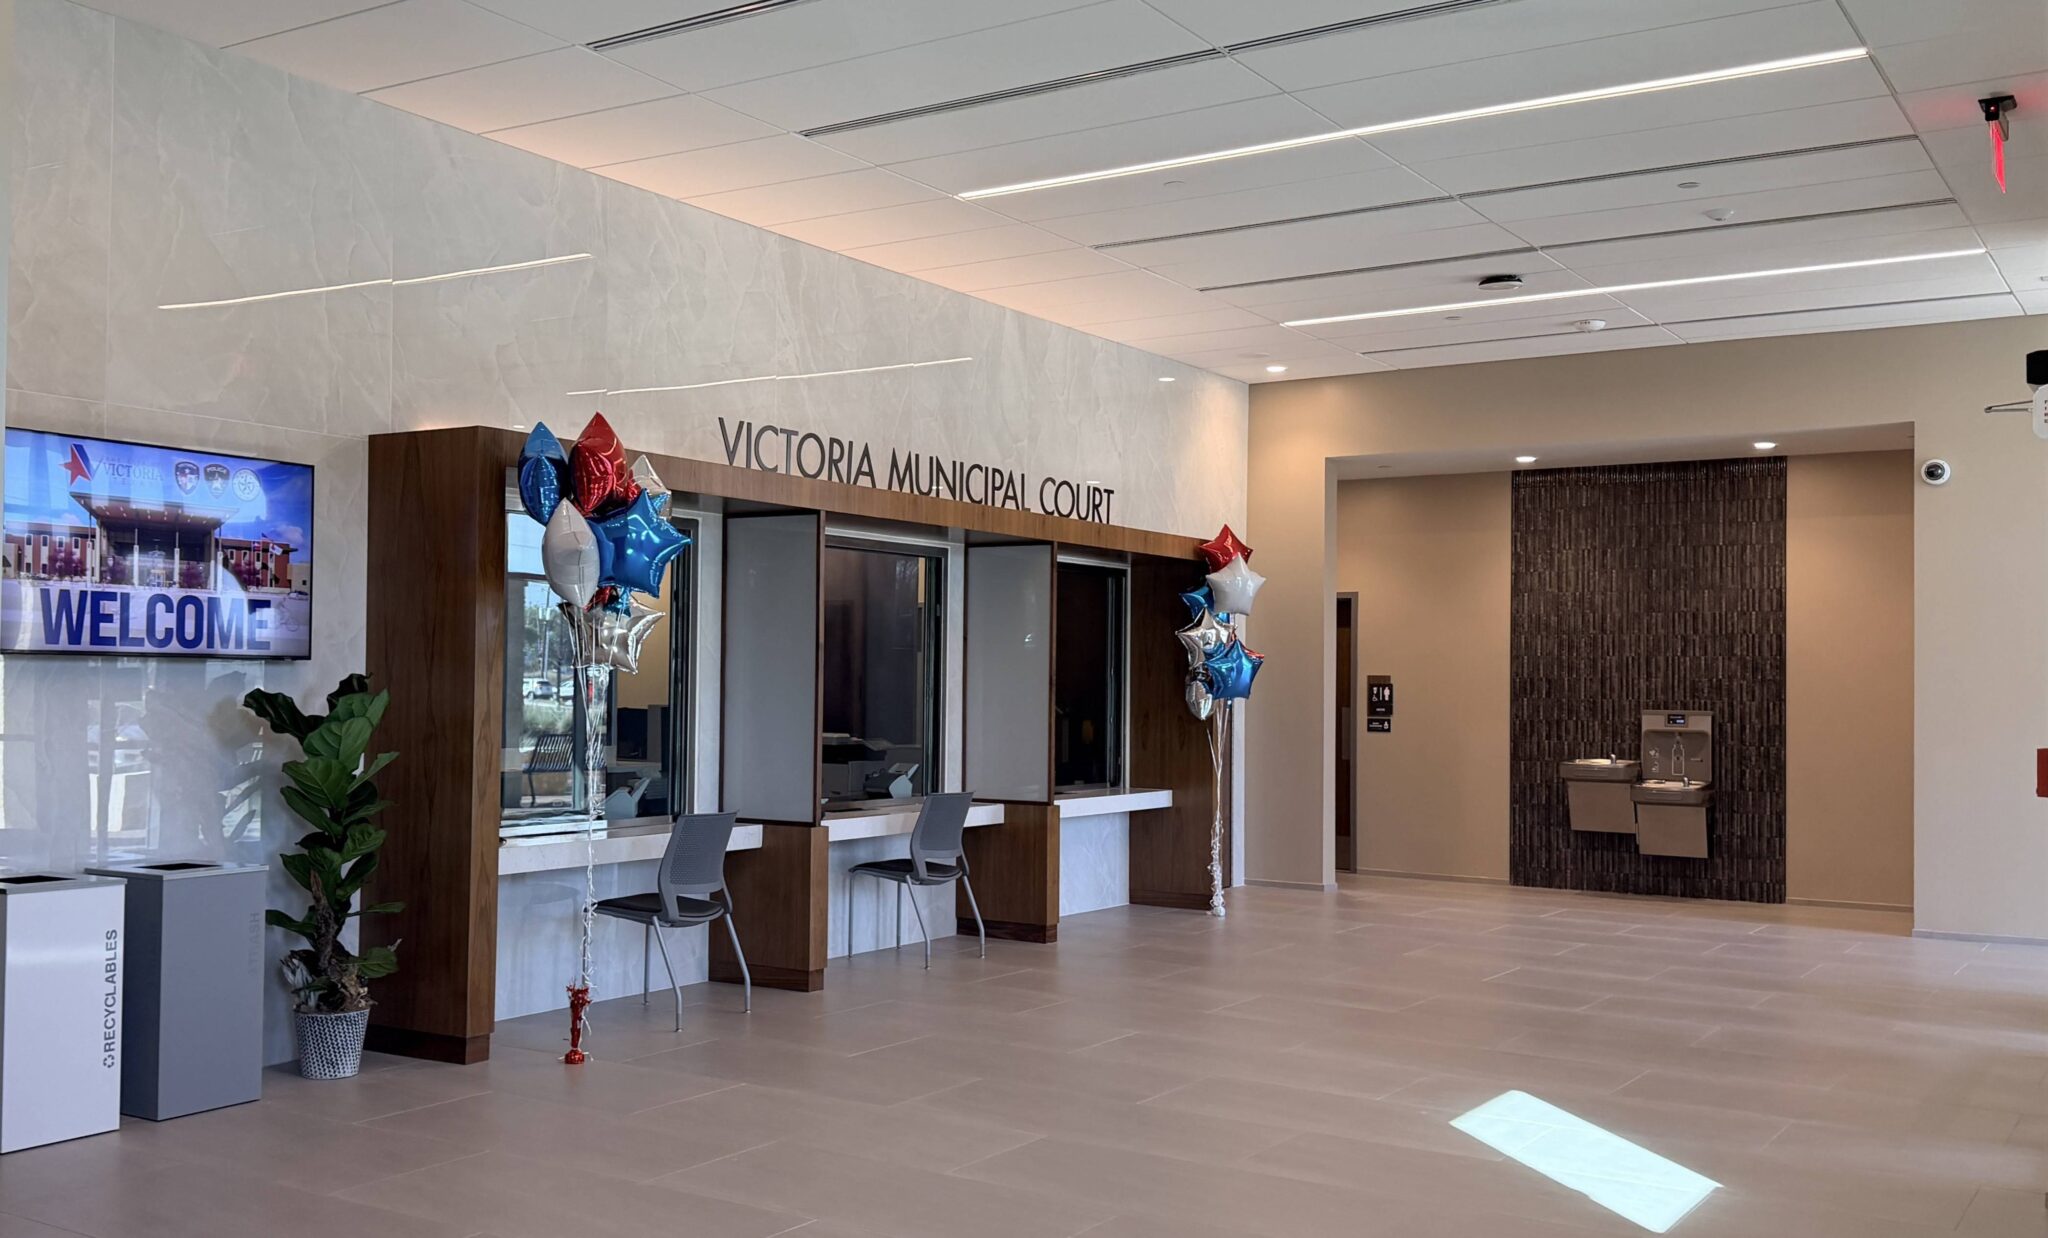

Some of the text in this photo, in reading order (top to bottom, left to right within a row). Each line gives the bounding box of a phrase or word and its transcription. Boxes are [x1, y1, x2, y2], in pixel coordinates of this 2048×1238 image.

[103, 462, 165, 481] VICTORIA
[718, 416, 1115, 525] VICTORIA MUNICIPAL COURT
[40, 588, 272, 651] WELCOME
[103, 929, 118, 1052] RECYCLABLES
